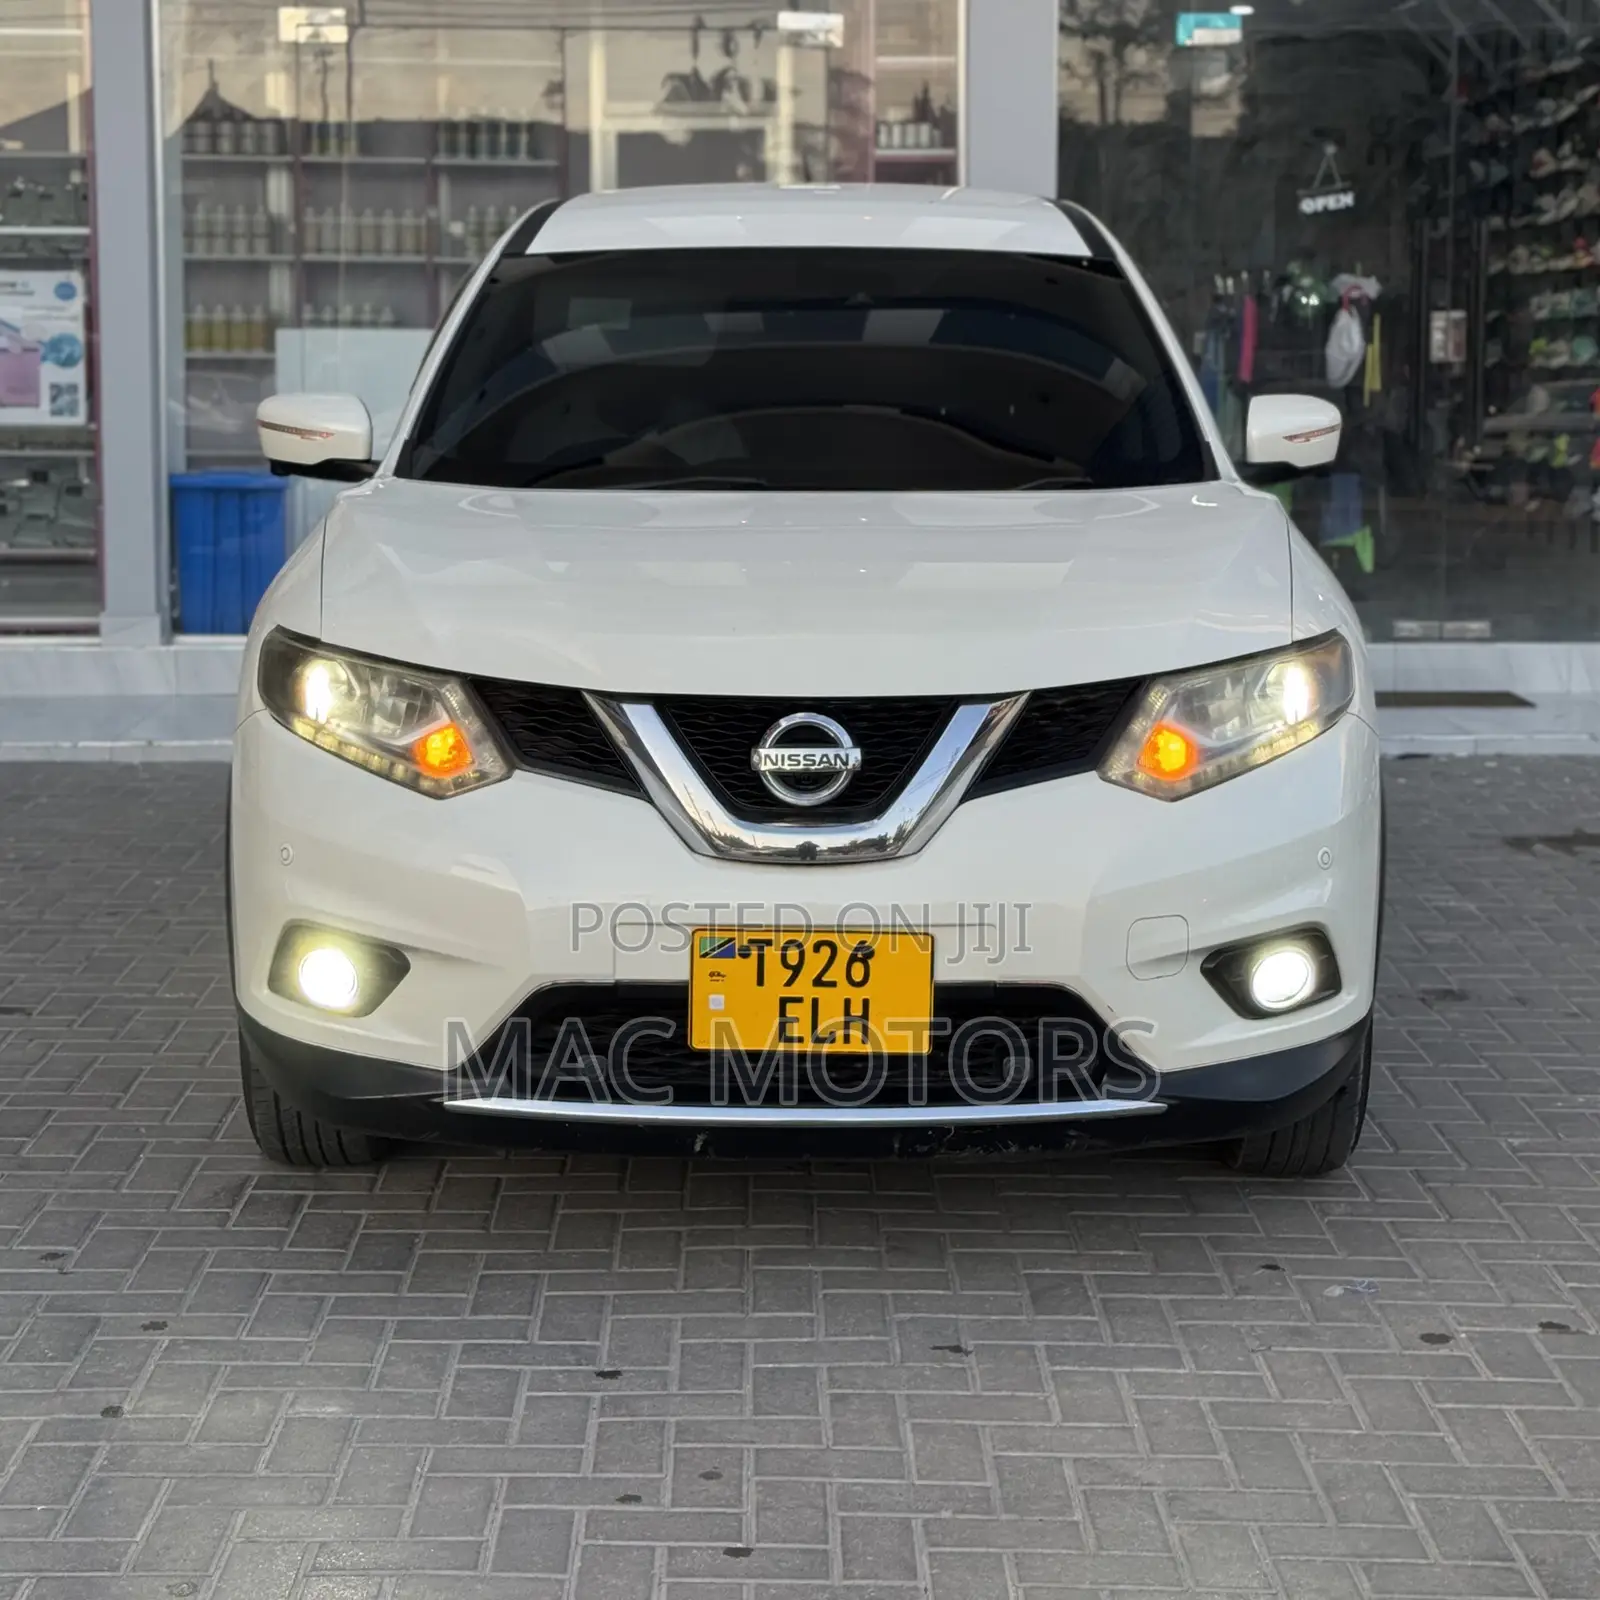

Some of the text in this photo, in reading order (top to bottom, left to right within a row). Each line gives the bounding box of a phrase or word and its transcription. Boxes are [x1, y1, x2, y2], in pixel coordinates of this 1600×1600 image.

[1299, 190, 1355, 215] OPEN
[763, 753, 850, 767] NISSAN
[747, 938, 871, 988] T926
[778, 995, 871, 1045] ELH
